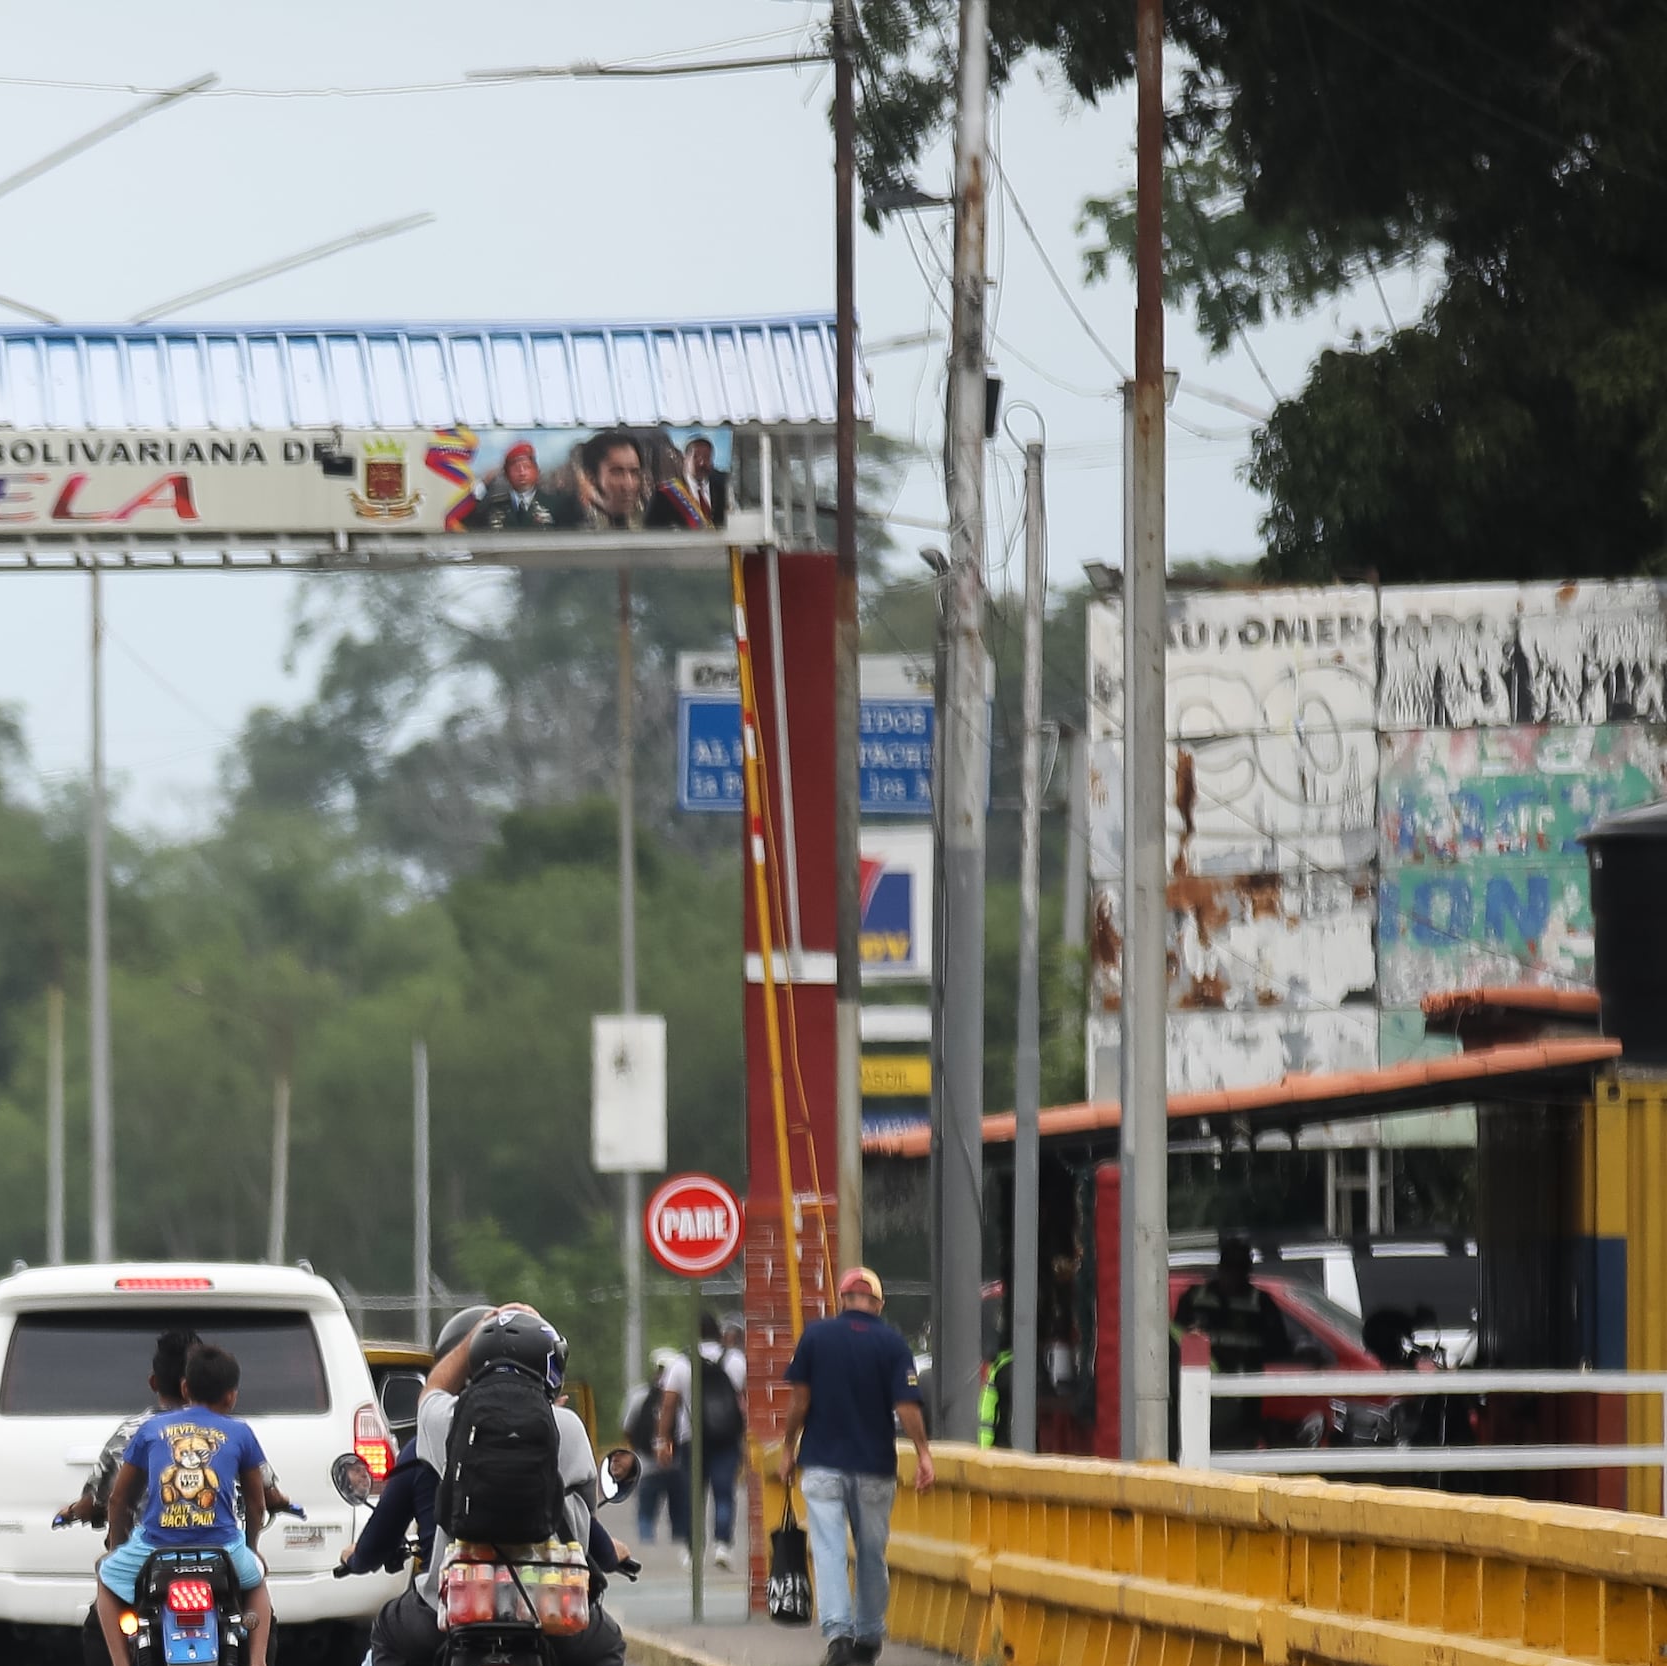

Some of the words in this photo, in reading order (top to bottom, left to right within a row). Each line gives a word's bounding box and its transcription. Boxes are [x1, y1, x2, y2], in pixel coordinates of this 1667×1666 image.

[662, 1205, 729, 1242] PARE
[160, 1514, 189, 1528] BACK
[191, 1513, 216, 1527] PAIN
